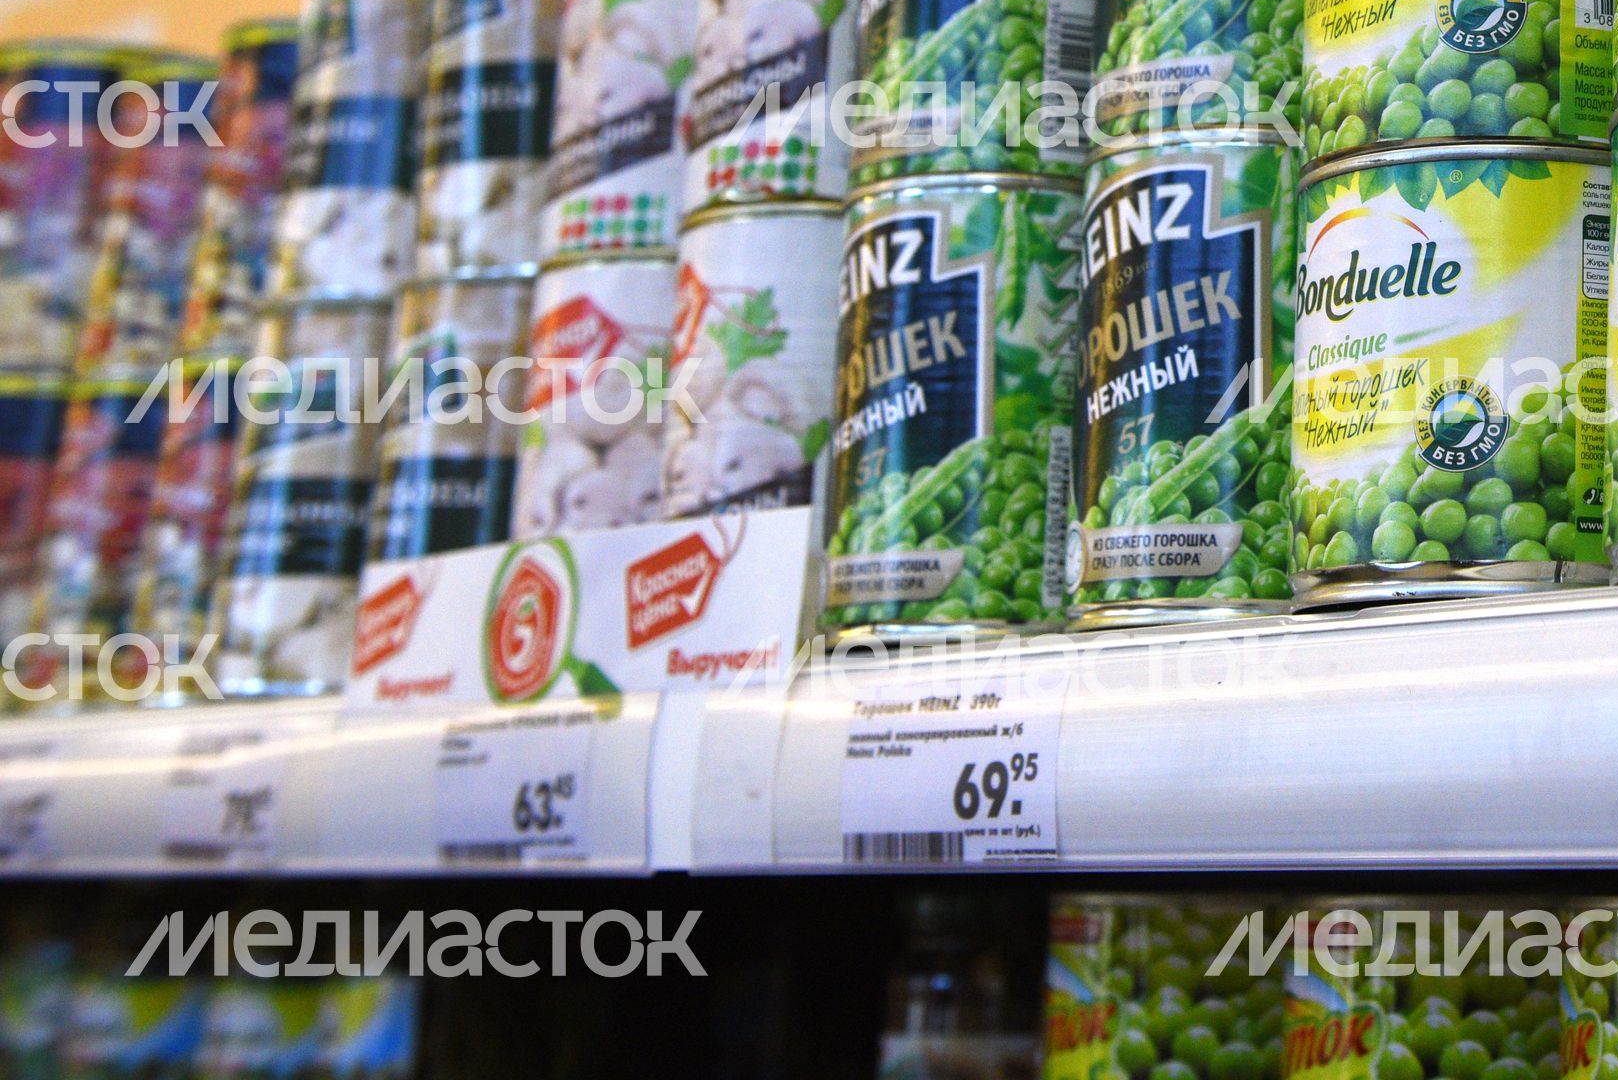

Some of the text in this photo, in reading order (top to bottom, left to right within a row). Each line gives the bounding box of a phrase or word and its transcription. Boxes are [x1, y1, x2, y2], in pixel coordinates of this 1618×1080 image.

[1452, 8, 1520, 48] БЕЗ ГМО
[1574, 34, 1613, 53] Объем/
[1574, 61, 1606, 78] Масса
[1574, 79, 1606, 96] Масса
[1574, 96, 1614, 113] продукт
[1296, 240, 1462, 322] Bonduelle
[1307, 332, 1389, 372] Classique
[1086, 343, 1200, 425] НЕЖНЫЙ
[1117, 413, 1156, 455] 57
[1431, 422, 1501, 466] БЕЗ ГМО
[1105, 534, 1152, 550] СВЕЖЕГО
[1153, 531, 1218, 548] ГОРОШКА
[1120, 553, 1156, 569] ПОСЛЕ
[1158, 550, 1201, 567] СБОРА
[631, 550, 709, 602] Красная
[632, 593, 681, 635] цена
[918, 694, 961, 713] HEINZ
[969, 693, 1002, 711] 390г
